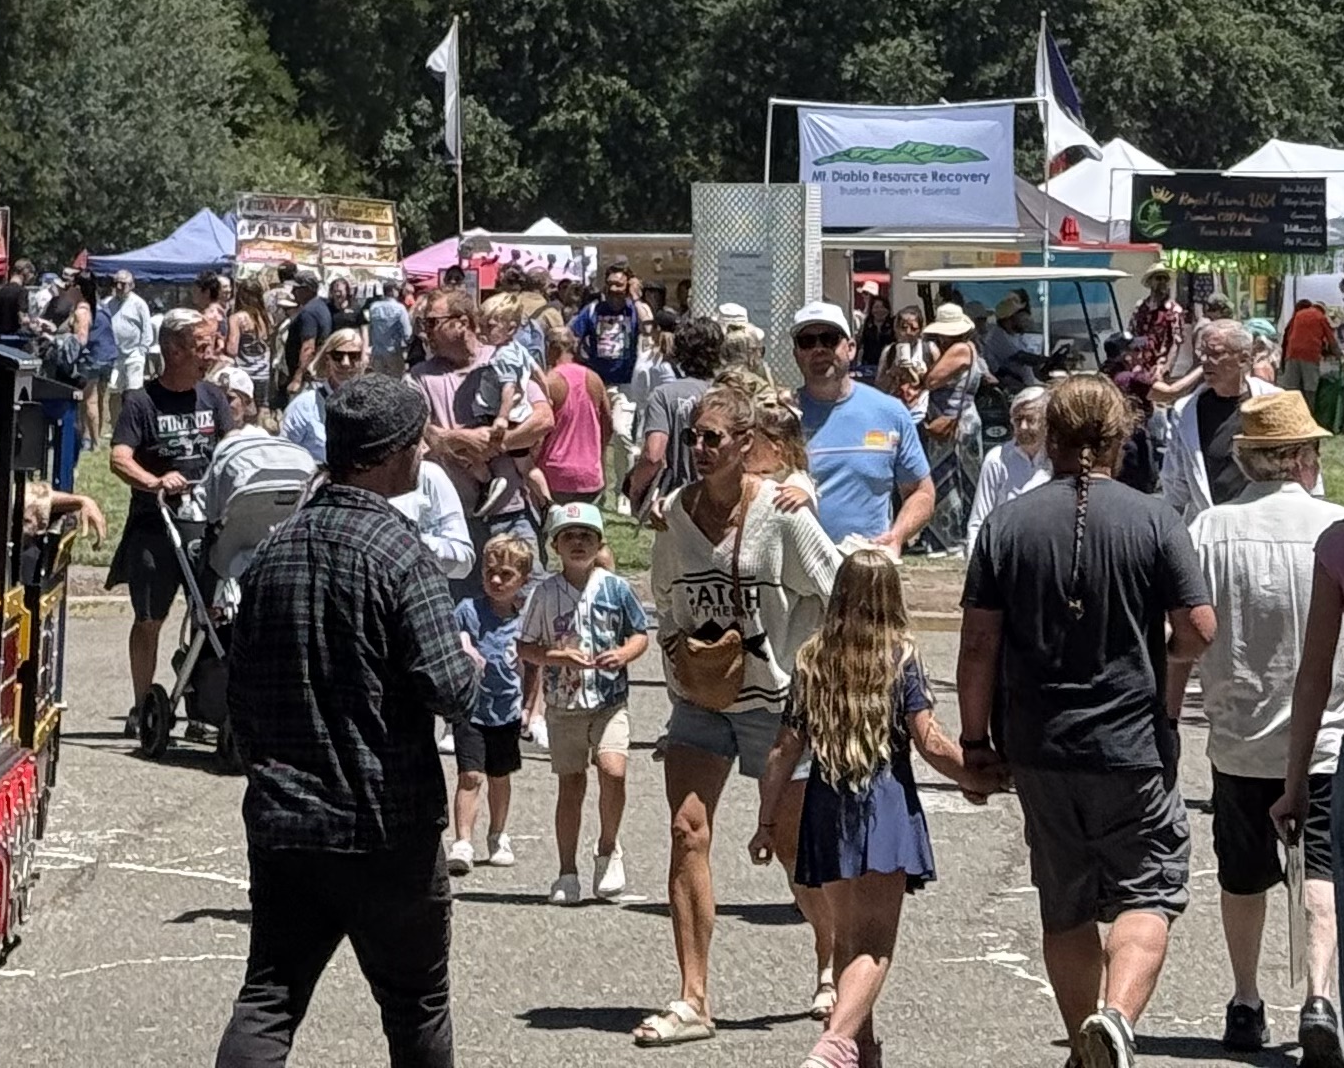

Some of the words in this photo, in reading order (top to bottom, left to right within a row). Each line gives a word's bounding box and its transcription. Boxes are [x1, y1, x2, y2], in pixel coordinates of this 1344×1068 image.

[832, 171, 869, 182] Diablo
[873, 171, 928, 183] Resource
[932, 171, 990, 185] Recovery
[157, 410, 215, 432] FIRENZE
